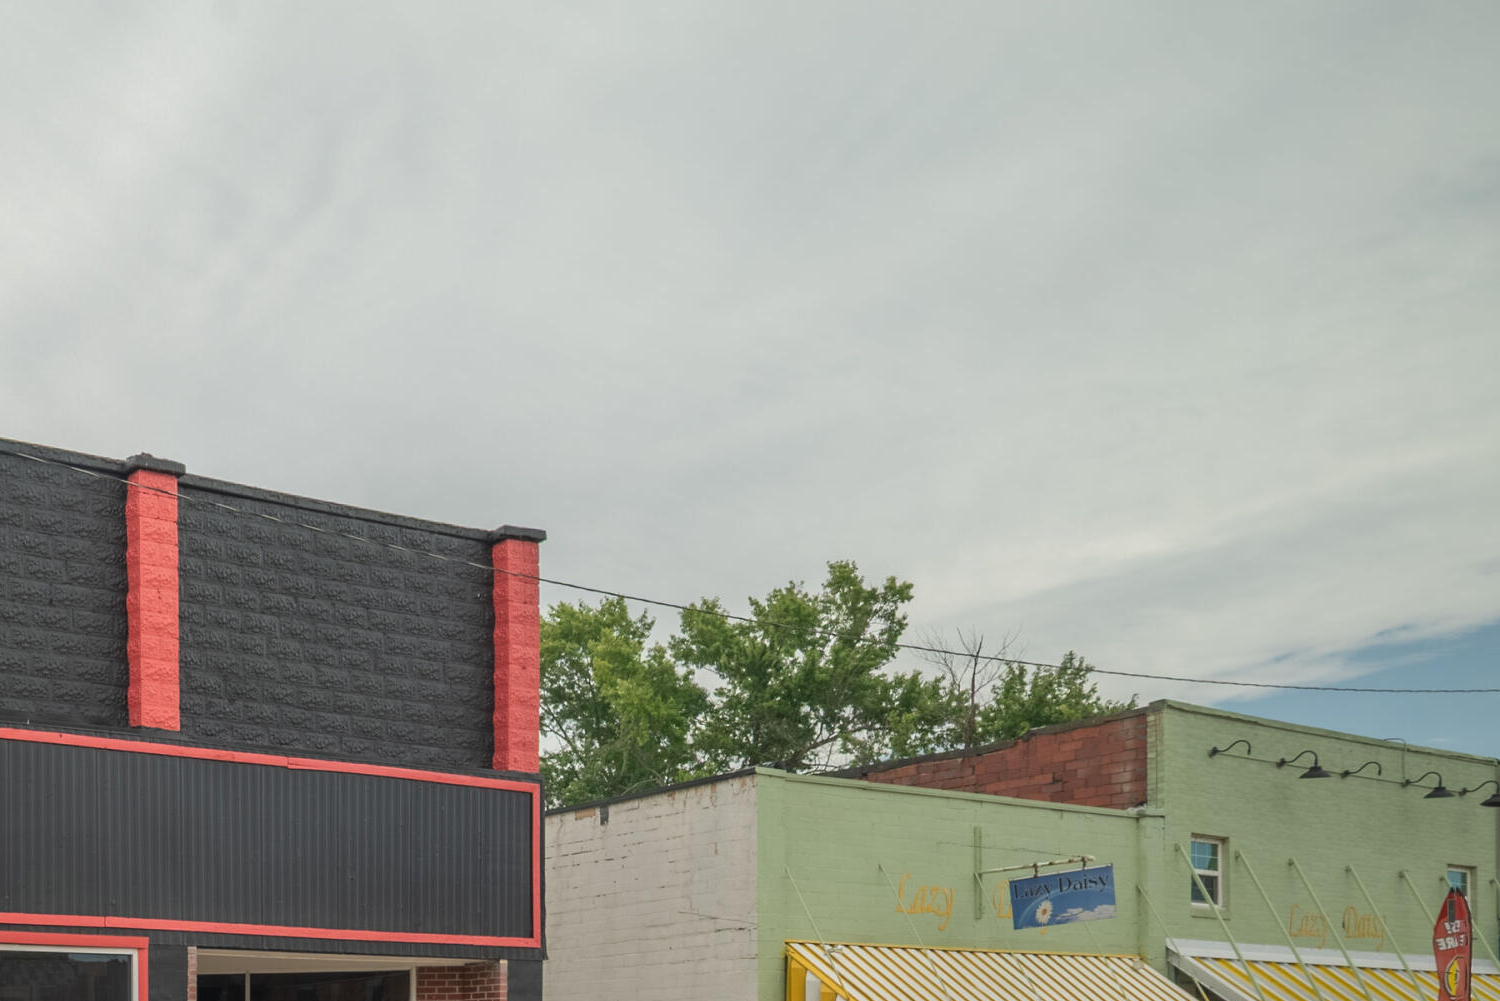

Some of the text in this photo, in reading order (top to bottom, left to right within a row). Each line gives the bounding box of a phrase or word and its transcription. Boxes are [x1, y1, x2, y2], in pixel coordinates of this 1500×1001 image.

[895, 872, 955, 931] Lazy
[1013, 883, 1053, 900] Lazy
[1059, 872, 1109, 893] Daisy
[1289, 903, 1327, 950] Lazy
